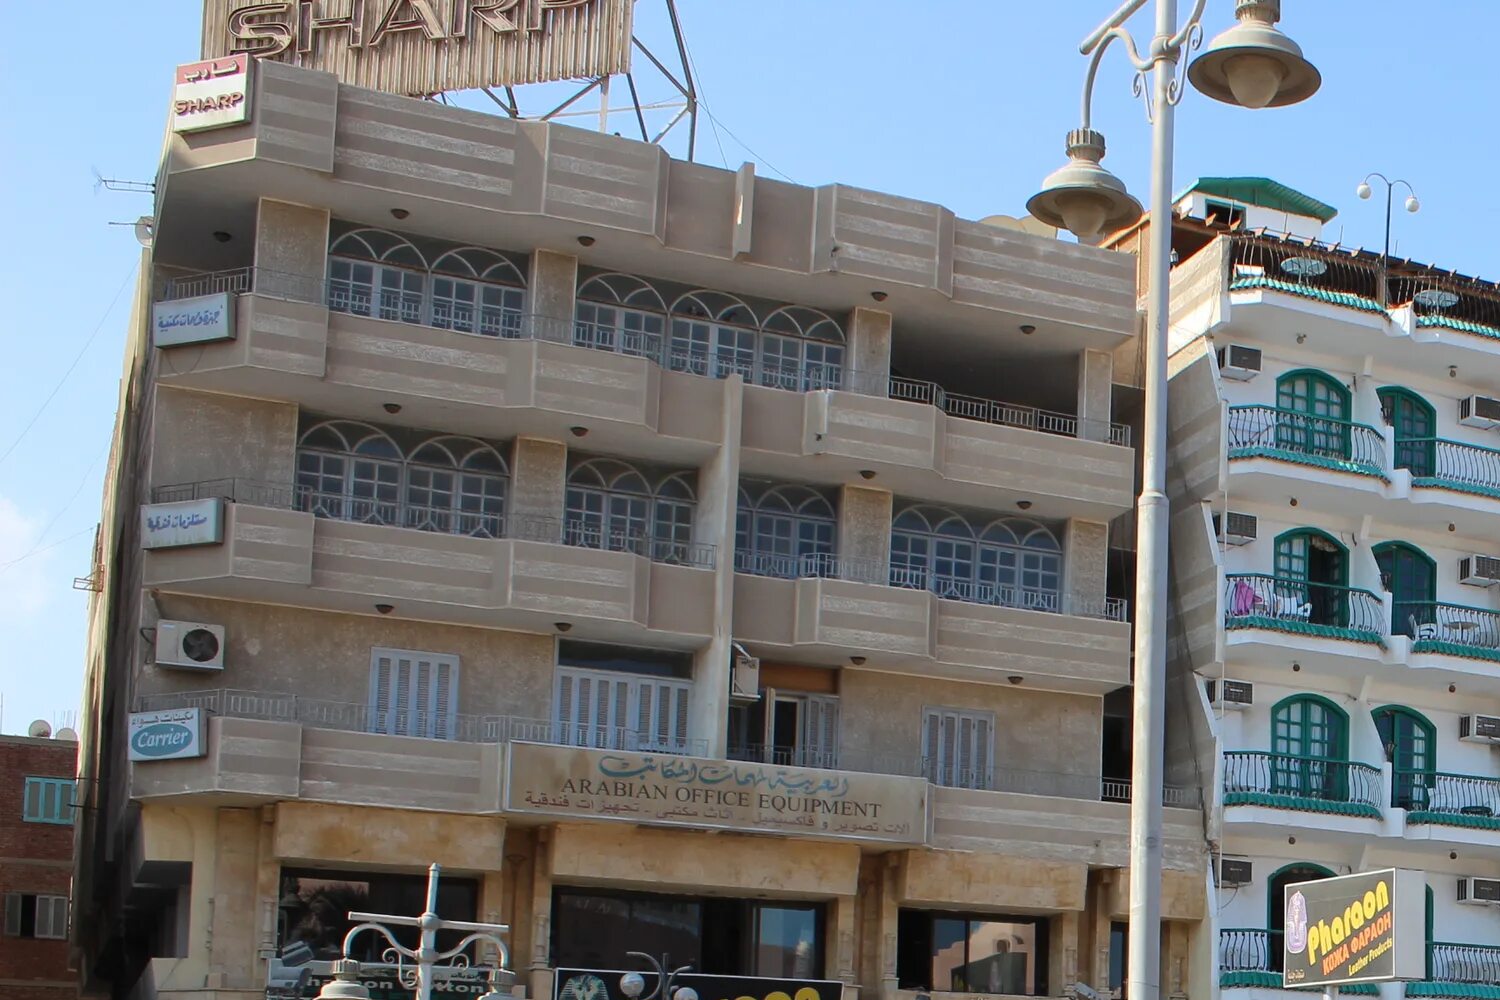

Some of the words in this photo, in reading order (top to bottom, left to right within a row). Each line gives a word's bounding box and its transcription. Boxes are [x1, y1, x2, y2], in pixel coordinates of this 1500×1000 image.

[183, 59, 240, 82] شارب
[174, 91, 243, 116] SHARP
[172, 513, 207, 530] مستلزمات
[137, 727, 189, 748] Carrier
[525, 791, 570, 808] فندقية
[561, 778, 669, 801] ARABIAN
[675, 786, 750, 807] OFFICE
[758, 794, 882, 818] EQUIPMENT
[1307, 881, 1389, 966] Pharaon
[1322, 943, 1350, 976] КОЖА
[1350, 911, 1392, 954] ФАРАОН
[1348, 955, 1369, 977] Leather
[1368, 937, 1393, 962] Products
